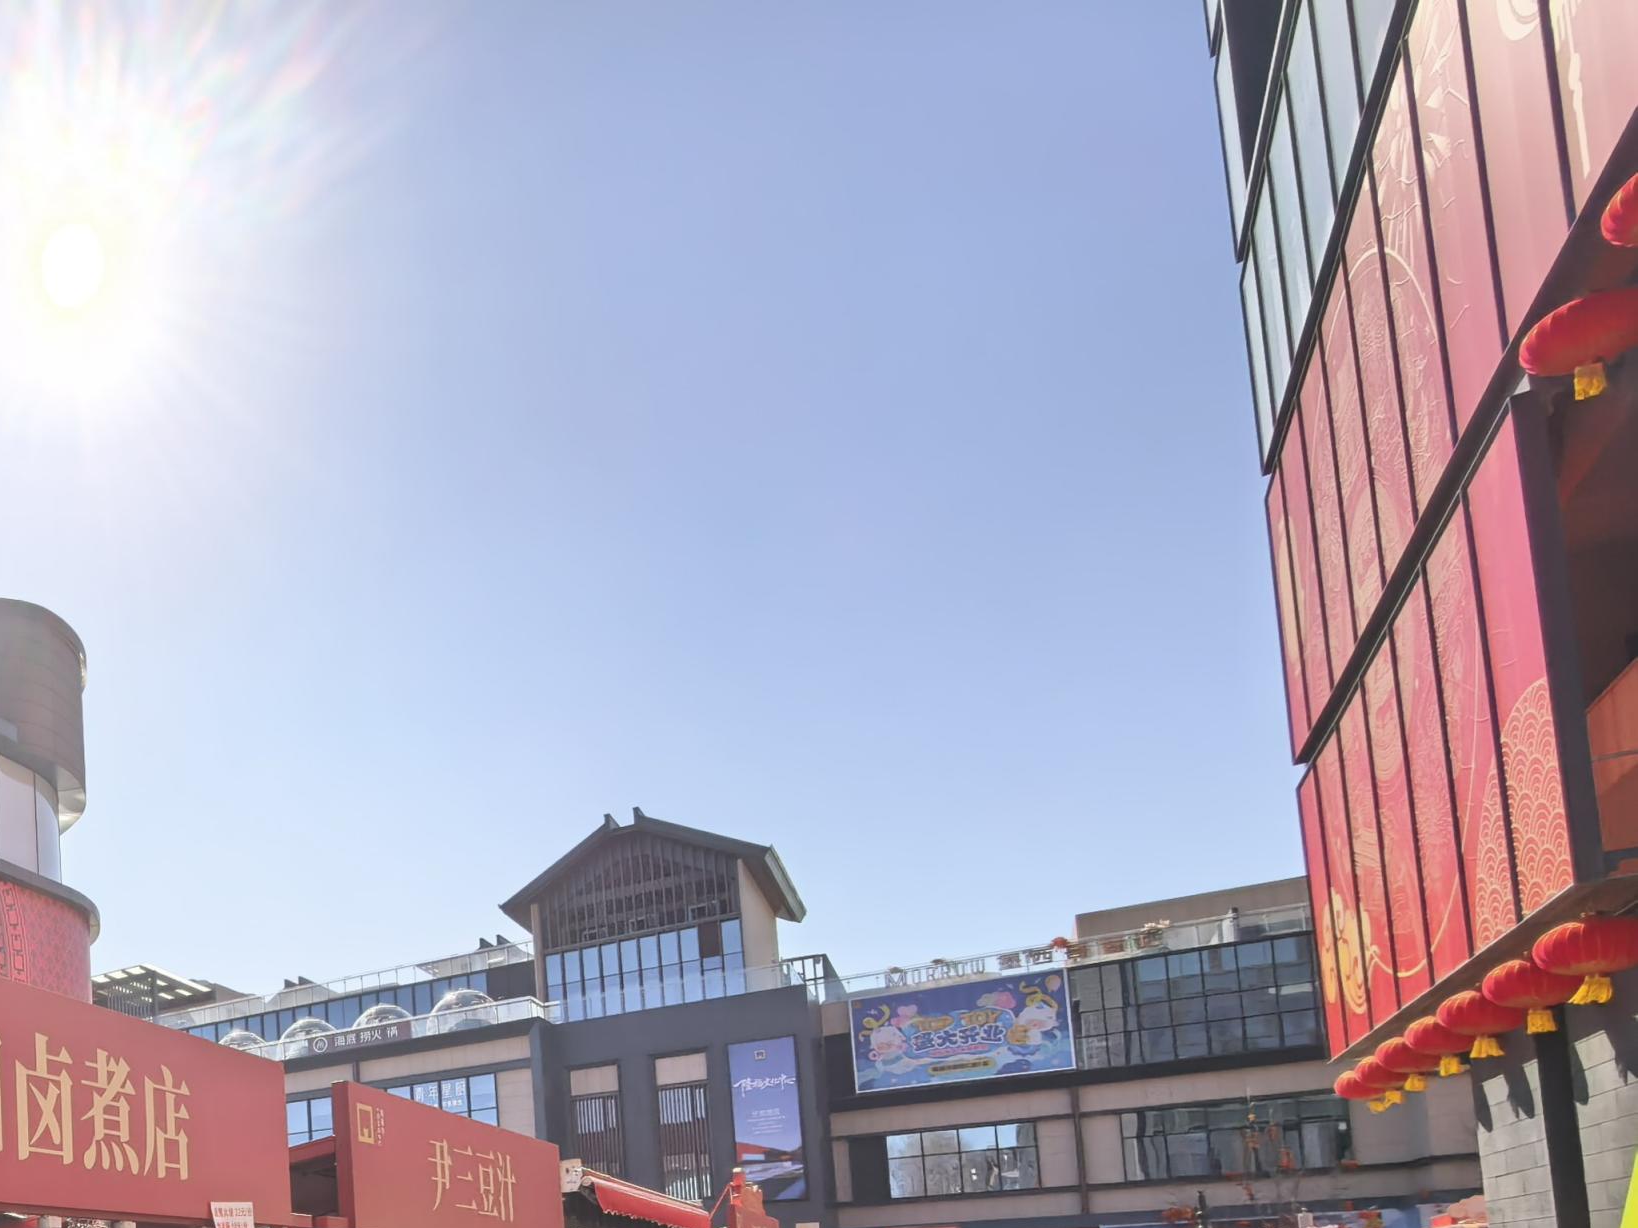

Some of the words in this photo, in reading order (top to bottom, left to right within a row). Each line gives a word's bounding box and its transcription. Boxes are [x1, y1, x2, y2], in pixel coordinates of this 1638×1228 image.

[333, 1025, 399, 1048] 海底捞火锅
[910, 1024, 1005, 1052] 盛大开业
[428, 1139, 517, 1222] 尹三豆汁
